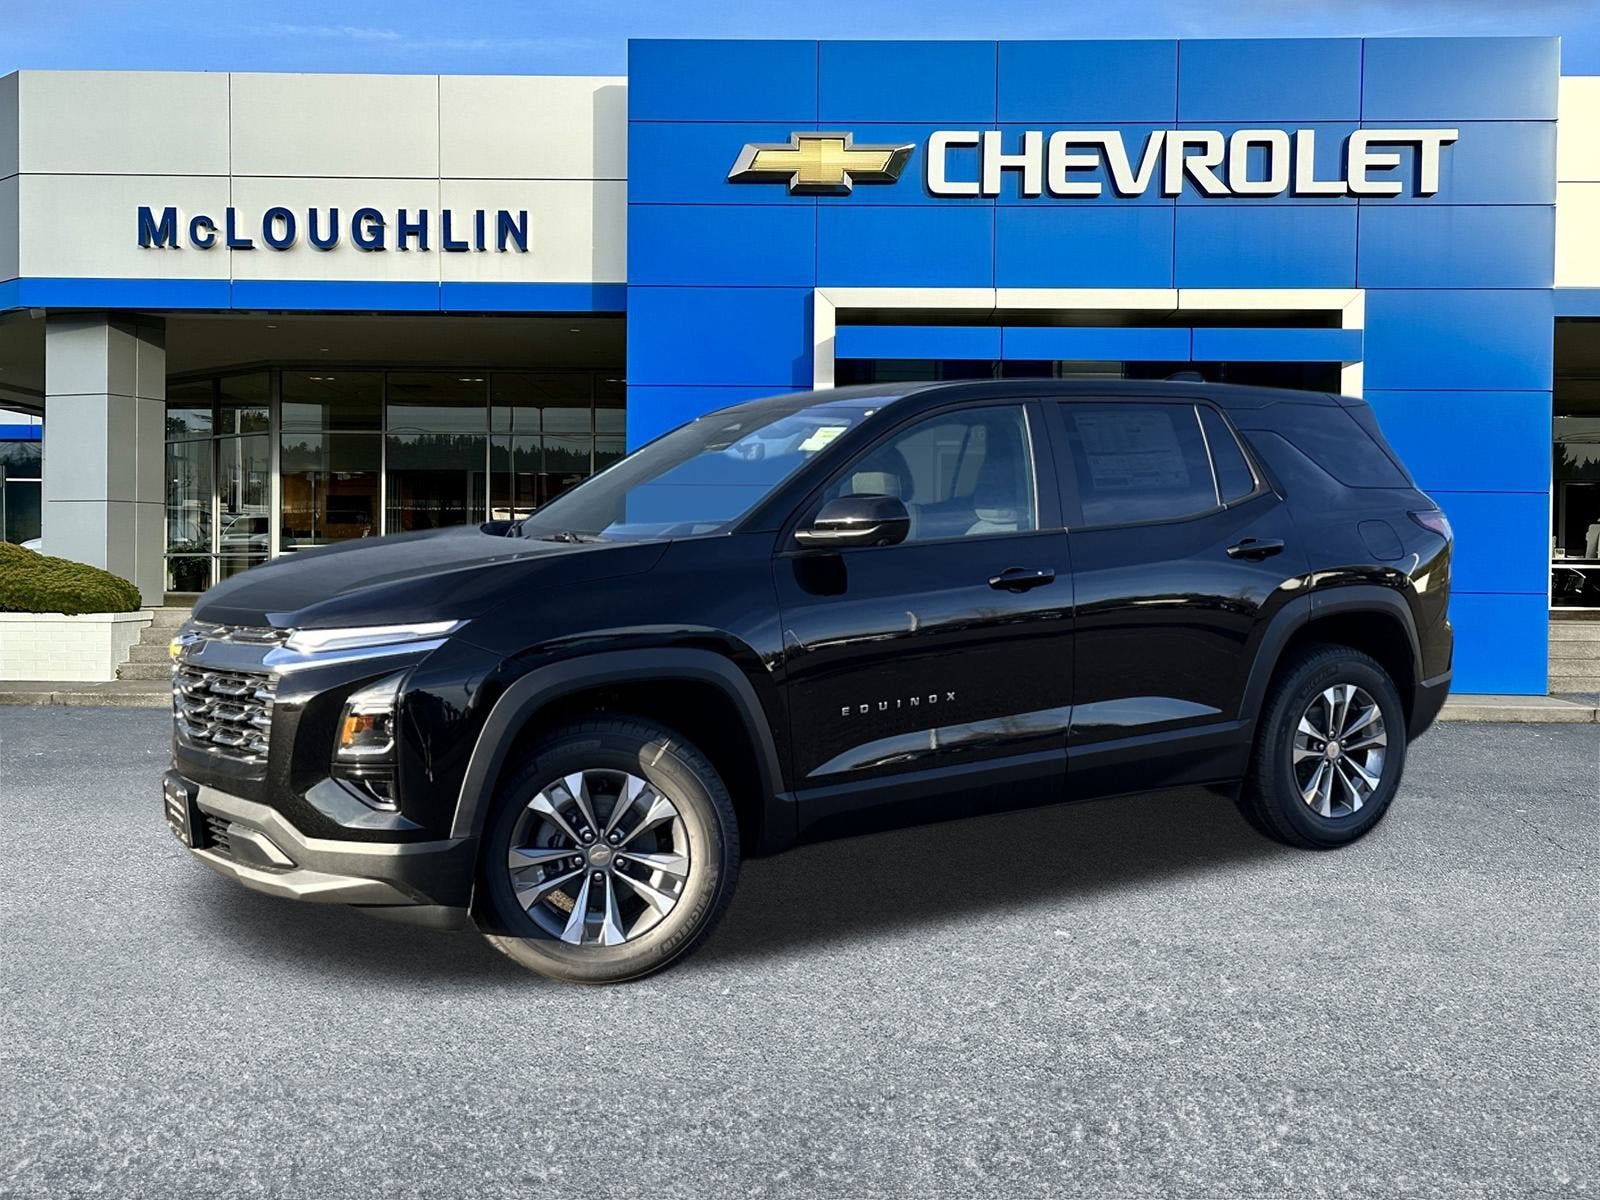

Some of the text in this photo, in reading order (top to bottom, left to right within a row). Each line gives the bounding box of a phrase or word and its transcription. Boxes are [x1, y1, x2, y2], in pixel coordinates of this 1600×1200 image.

[927, 128, 1459, 196] CHEVROLET
[137, 206, 530, 252] McLOUGHLIN
[841, 691, 956, 717] EQUINOX
